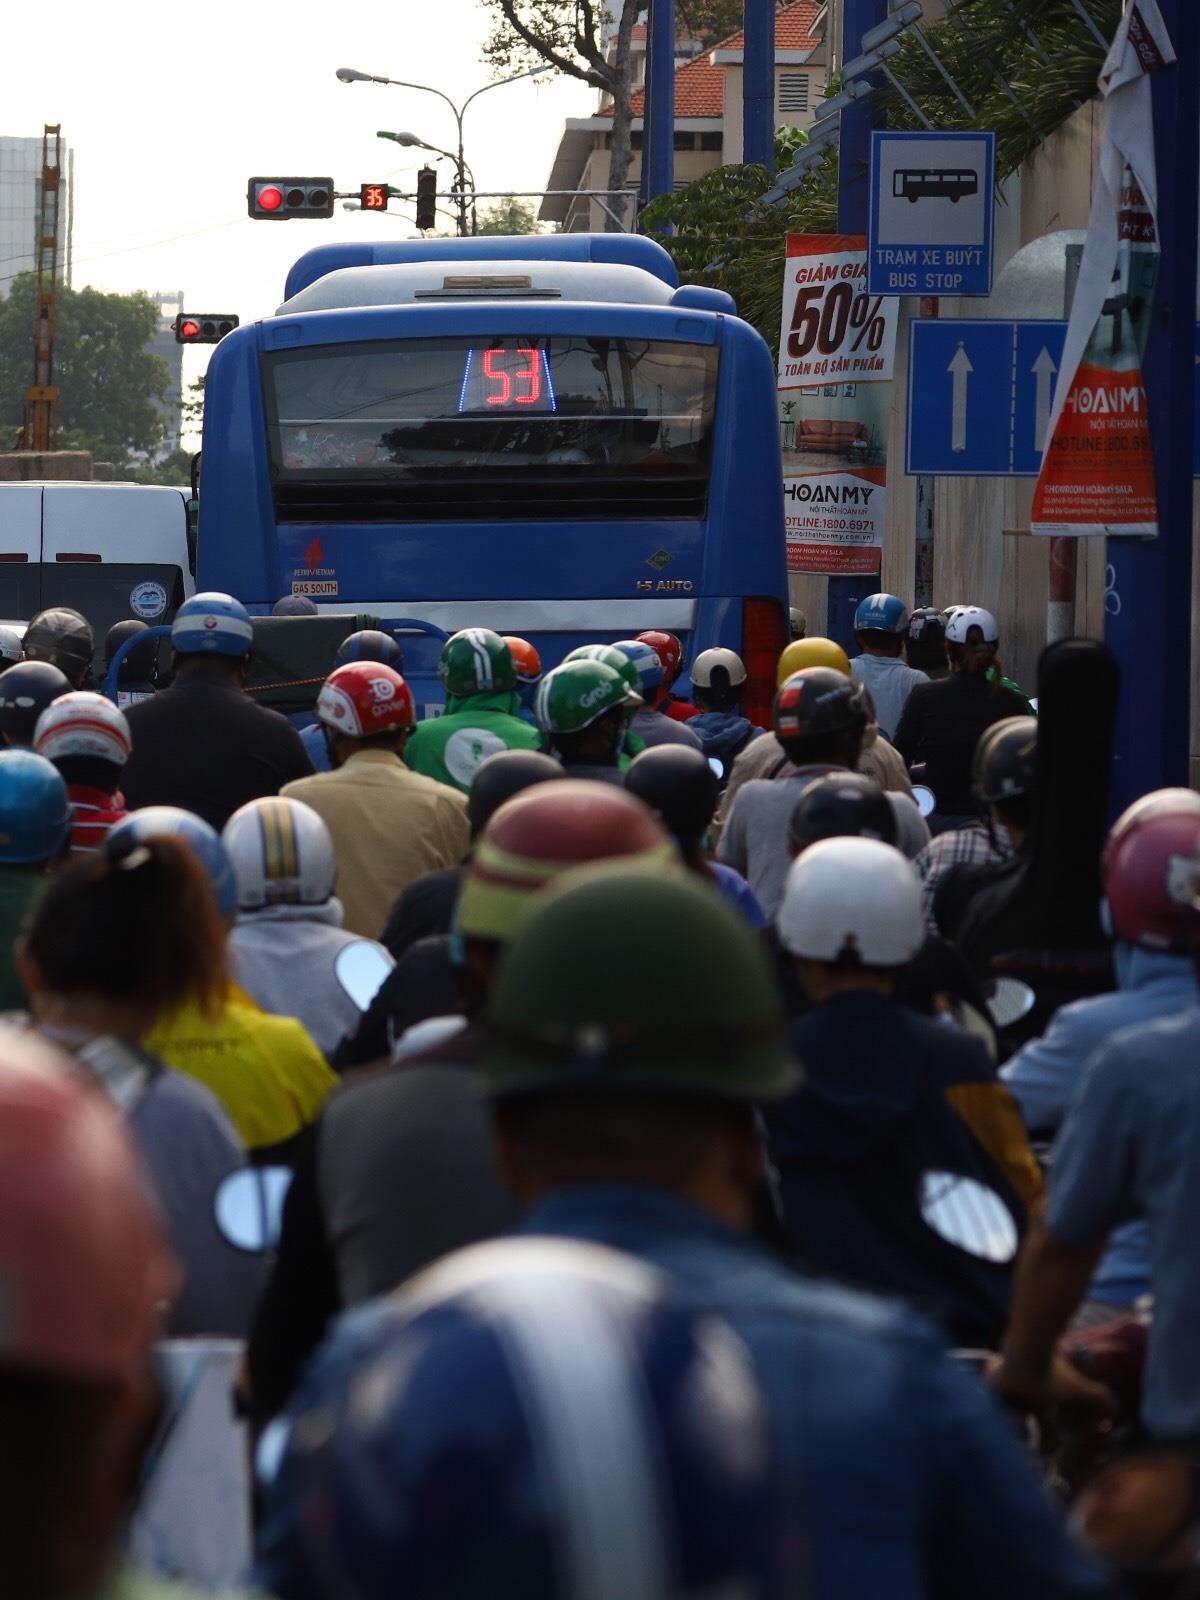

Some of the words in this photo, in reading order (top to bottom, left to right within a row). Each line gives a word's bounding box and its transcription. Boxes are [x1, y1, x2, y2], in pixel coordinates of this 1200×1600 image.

[366, 188, 383, 207] 35
[876, 249, 917, 268] TRẠM
[922, 250, 940, 265] XE
[946, 246, 983, 265] BUÝT
[795, 262, 839, 284] GIẢM
[889, 272, 917, 288] BUS
[925, 273, 963, 288] STOP
[787, 281, 886, 359] 50%
[484, 348, 540, 404] 53
[785, 360, 812, 377] TOÀN
[813, 358, 829, 376] BỘ
[830, 355, 850, 373] SẢN
[853, 353, 885, 371] PHẨM
[785, 516, 874, 531] OTLINE:1800.6971
[293, 583, 309, 594] GAS
[310, 583, 337, 593] SOUTH
[656, 580, 693, 592] AUTO
[579, 679, 614, 709] Grab
